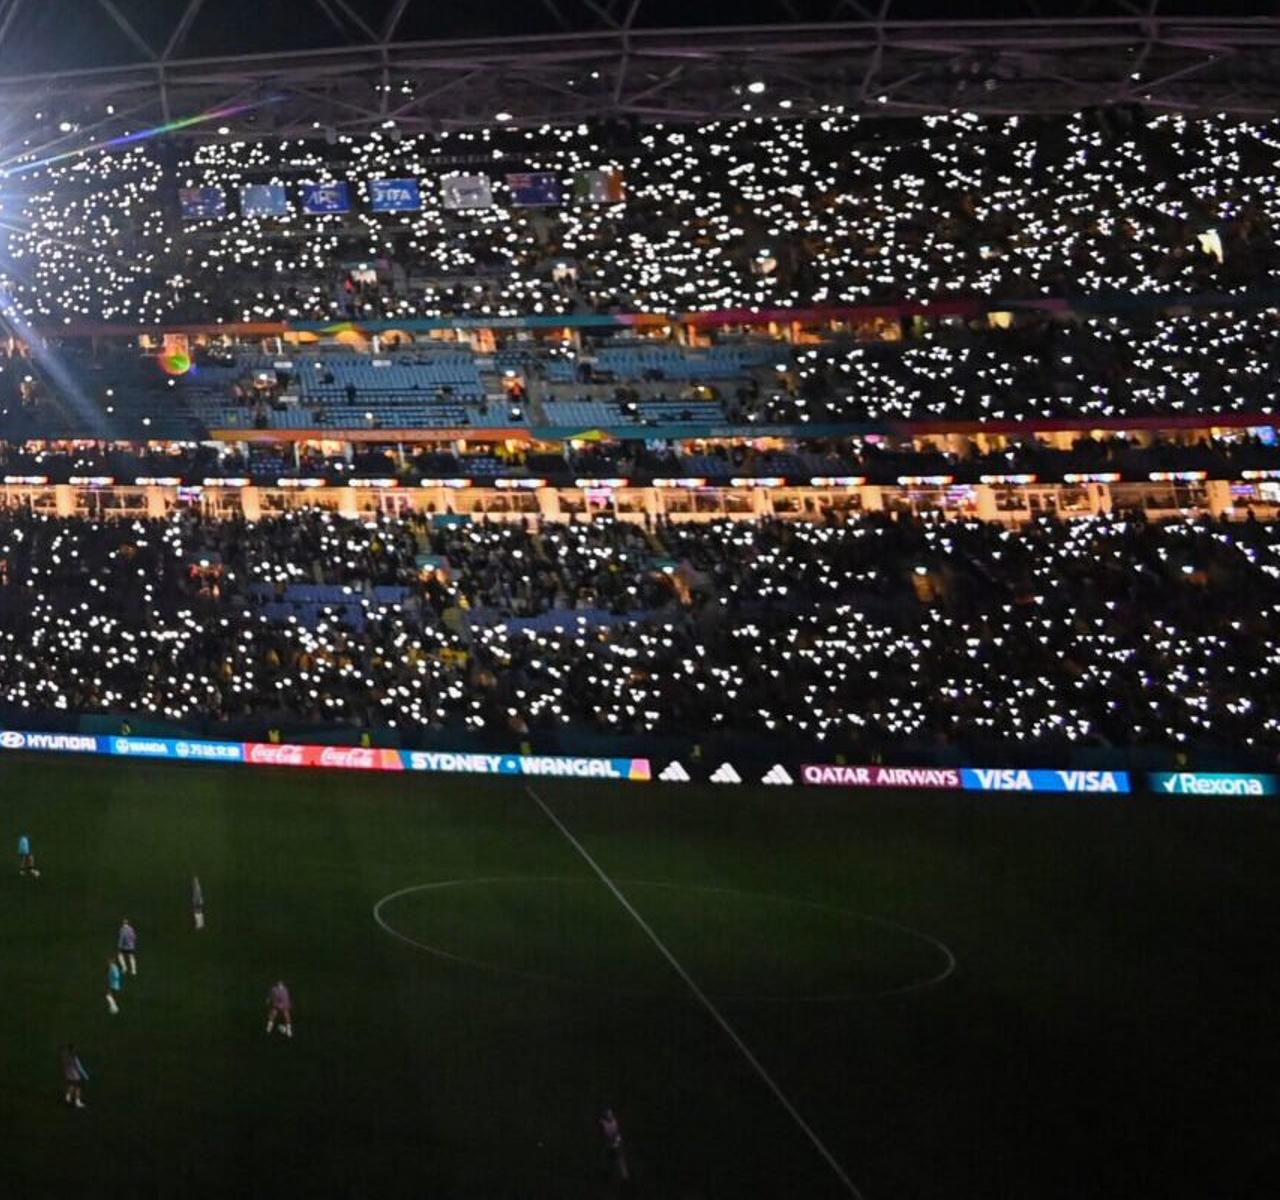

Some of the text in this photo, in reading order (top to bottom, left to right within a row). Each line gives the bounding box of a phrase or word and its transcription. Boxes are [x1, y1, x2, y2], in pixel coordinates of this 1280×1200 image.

[27, 735, 97, 751] HYUNDAI
[411, 752, 620, 778] SYDNEY WANGAL
[804, 766, 958, 786] QATAR AIRWAYS
[971, 769, 1118, 791] VISA VISA
[1179, 773, 1264, 794] Rexona
